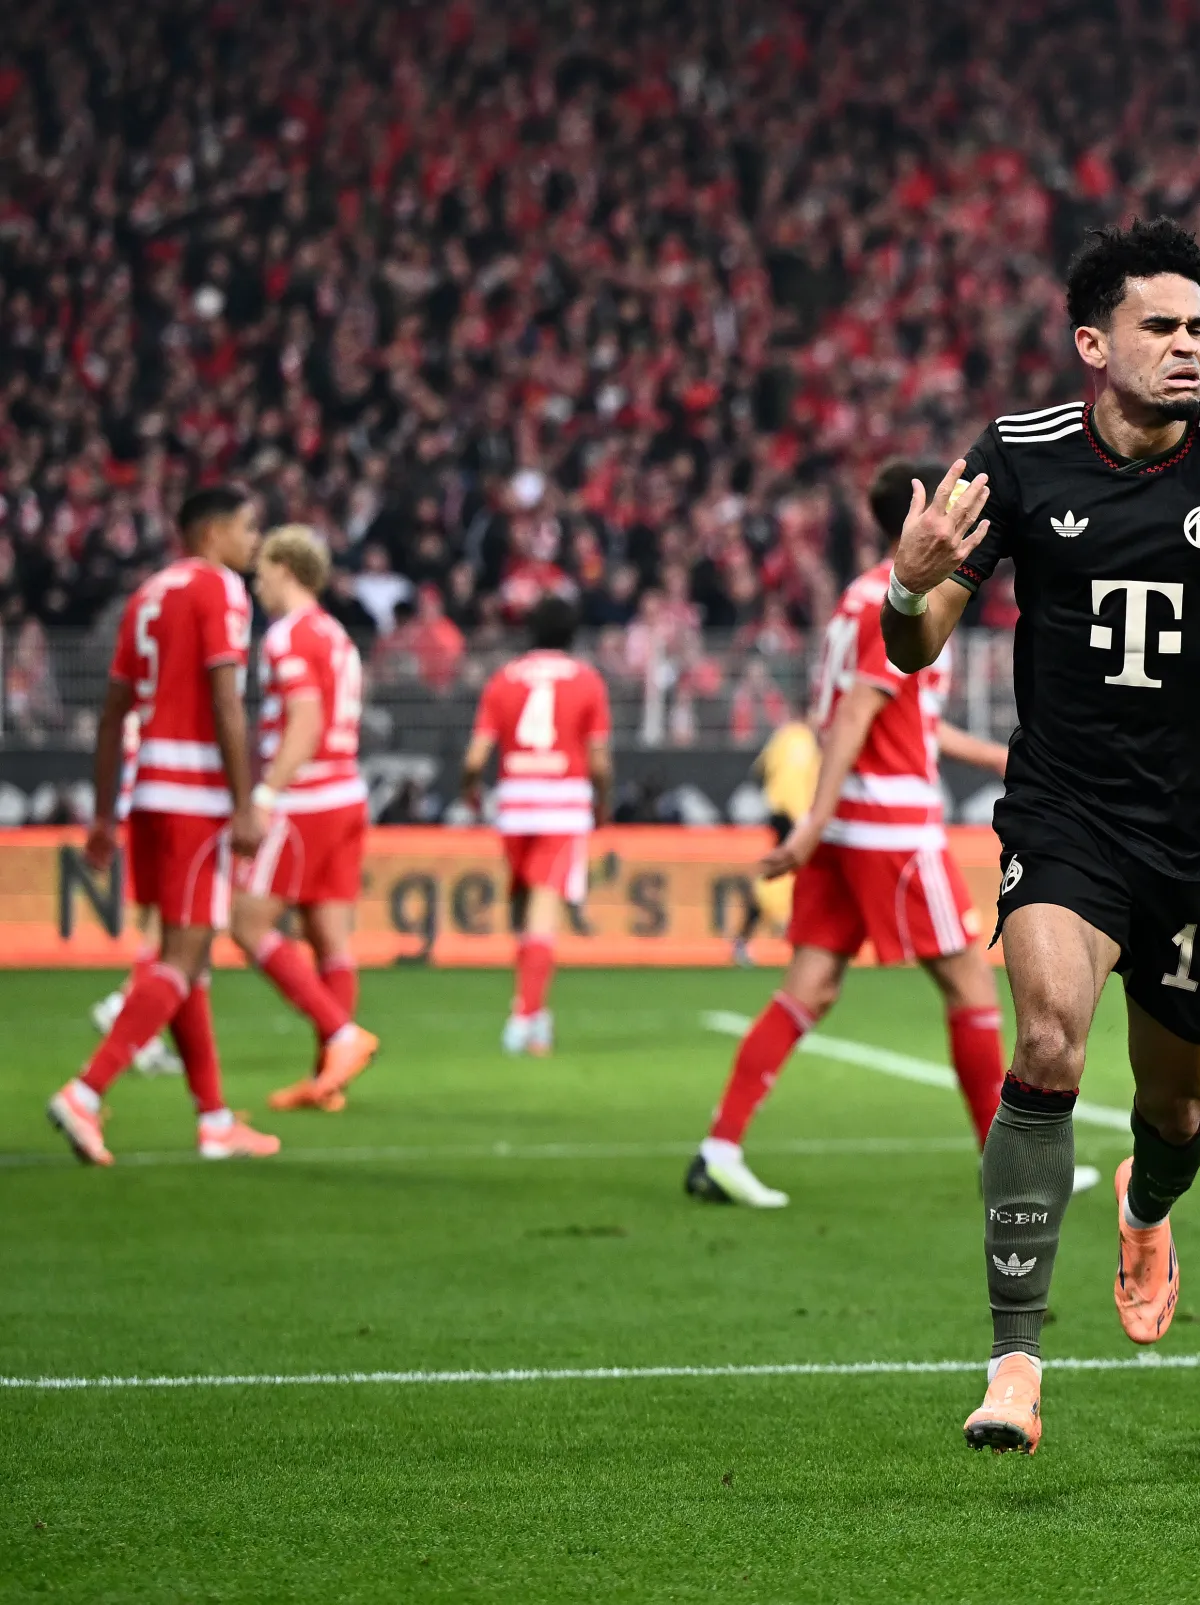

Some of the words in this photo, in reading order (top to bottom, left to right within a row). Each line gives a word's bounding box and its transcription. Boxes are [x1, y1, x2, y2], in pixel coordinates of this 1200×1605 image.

[135, 601, 161, 698] 5
[1089, 579, 1184, 689] T
[514, 678, 559, 749] 4
[989, 1207, 1048, 1225] FCBM
